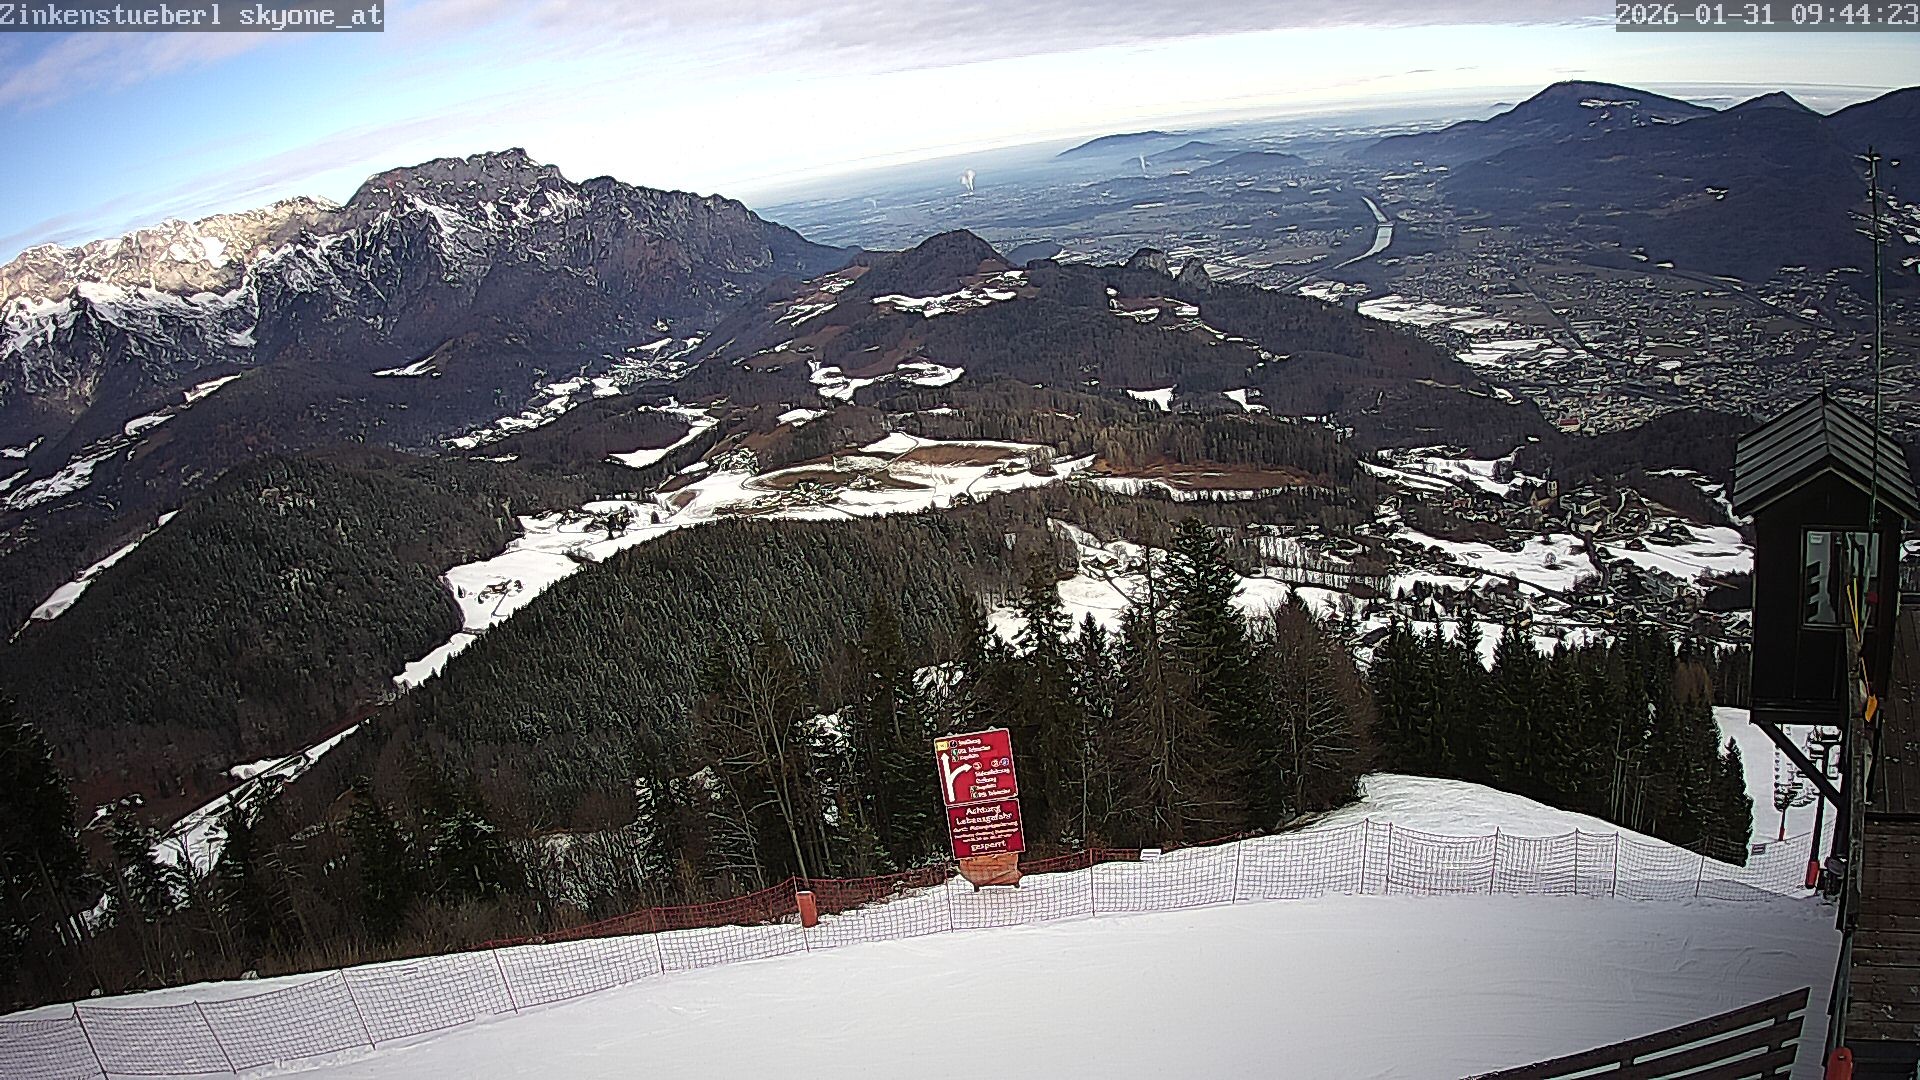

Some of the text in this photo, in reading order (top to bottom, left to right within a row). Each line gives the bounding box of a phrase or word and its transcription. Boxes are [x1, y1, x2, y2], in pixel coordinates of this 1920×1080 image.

[966, 805, 1001, 815] Achtung
[956, 812, 1012, 825] Lebensgefahr
[971, 840, 1006, 851] gesperrt
